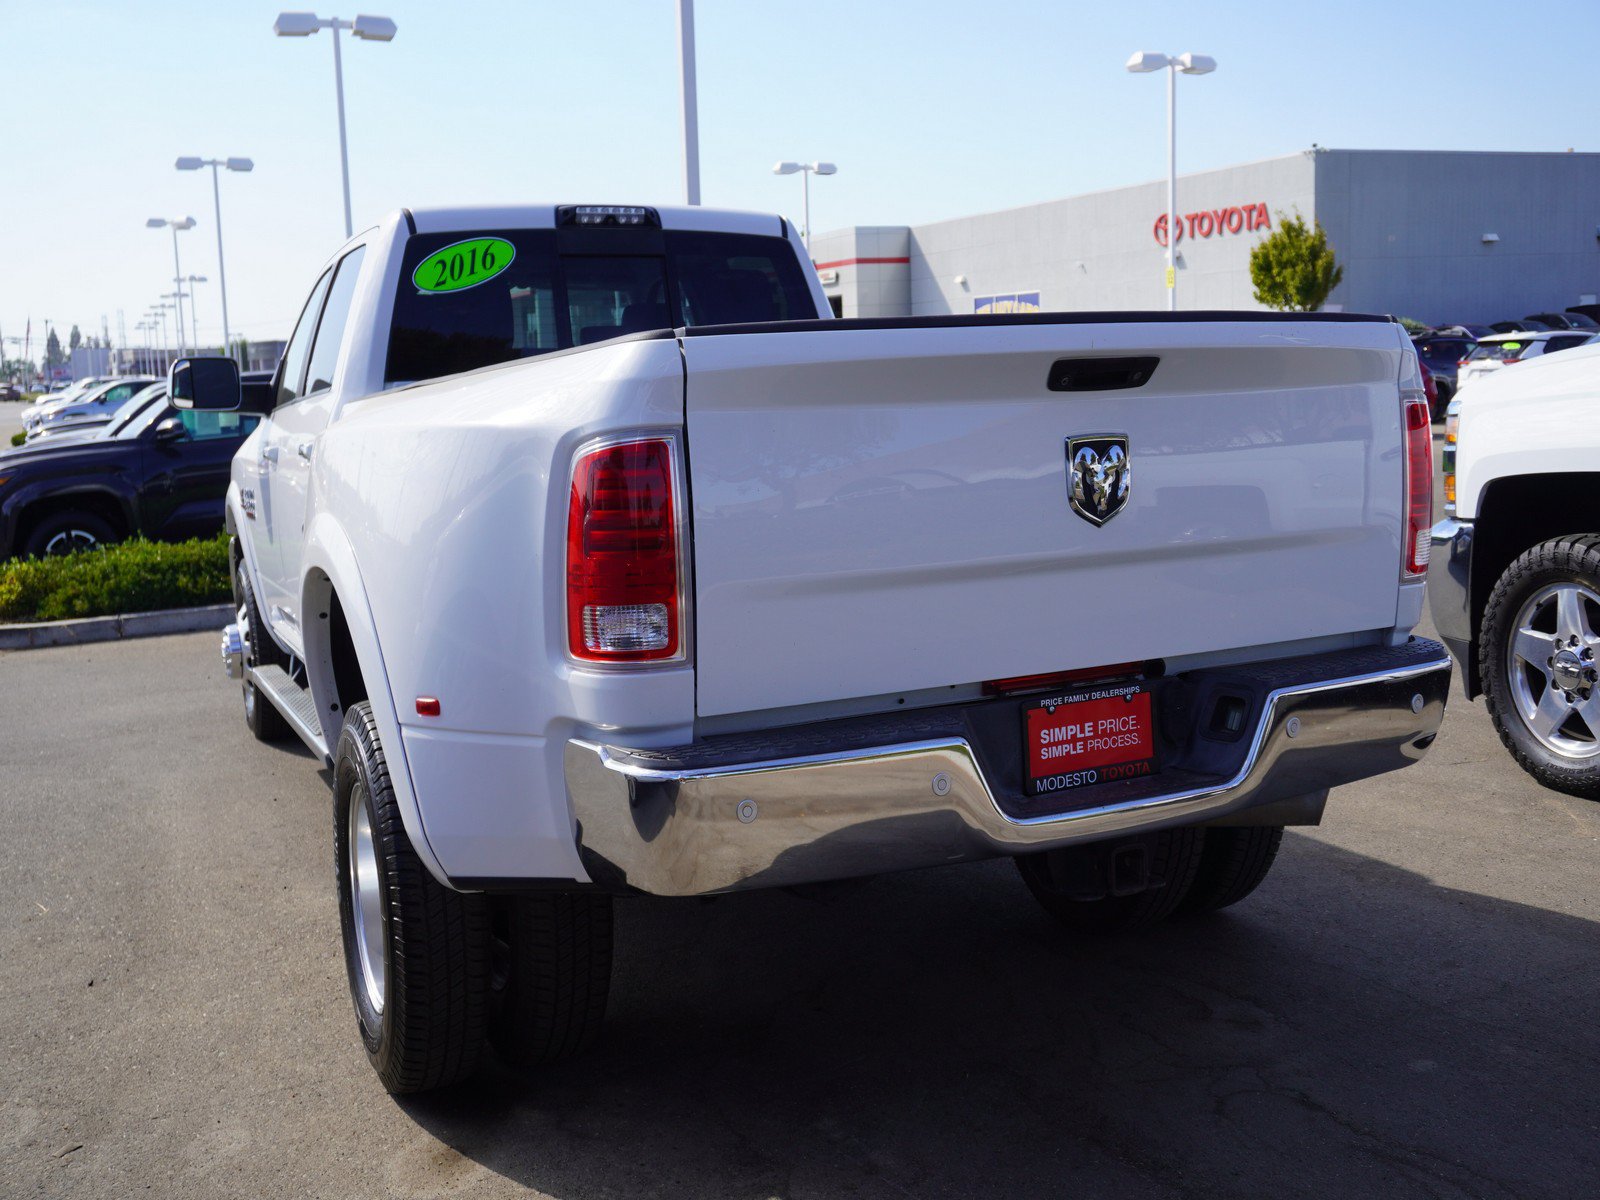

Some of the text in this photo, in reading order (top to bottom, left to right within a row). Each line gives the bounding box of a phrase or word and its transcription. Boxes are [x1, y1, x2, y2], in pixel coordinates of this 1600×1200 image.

[1185, 202, 1271, 239] TOYOTA
[433, 241, 495, 288] 2016
[1040, 686, 1140, 707] PRICE FAMILY DEALERSHIPS
[1040, 715, 1141, 744] SIMPLE PRICE.
[1040, 732, 1142, 760] SIMPLE PROCESS.
[1036, 761, 1151, 793] MODESTO TOYOTA
